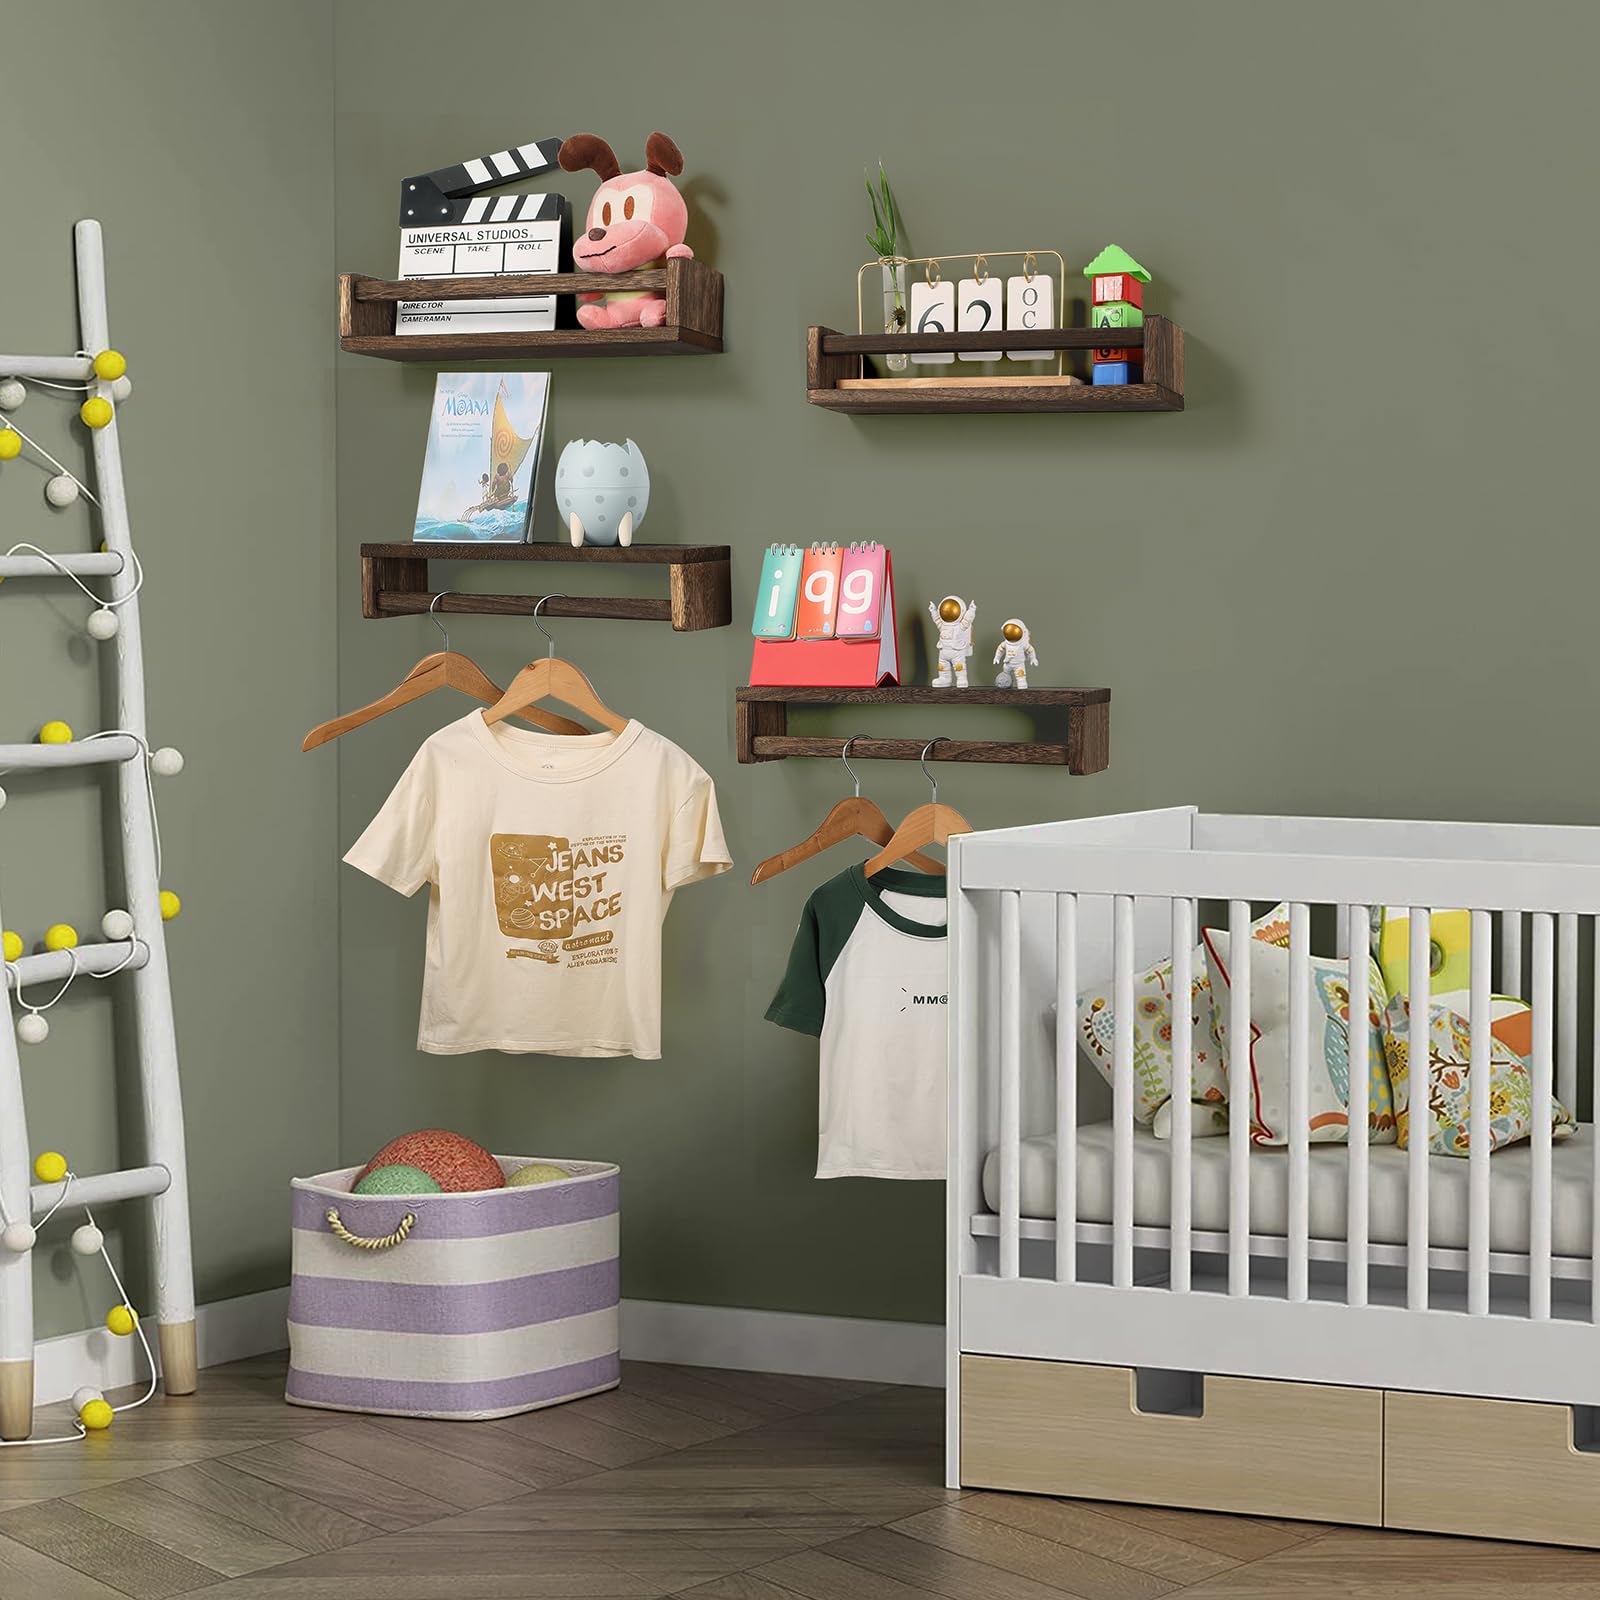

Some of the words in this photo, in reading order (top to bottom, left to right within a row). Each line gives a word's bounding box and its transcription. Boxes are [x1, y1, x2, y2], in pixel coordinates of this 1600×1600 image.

[408, 231, 473, 244] UNIVERSAL
[476, 228, 529, 241] STUDIOS
[413, 247, 446, 255] SCENE
[516, 243, 543, 251] ROLL
[401, 315, 452, 323] CAMERAMAN
[441, 397, 489, 416] MOANA
[545, 844, 624, 873] JEANS
[531, 871, 607, 902] WEST
[539, 892, 622, 930] SPACE
[565, 931, 611, 950] astronaut
